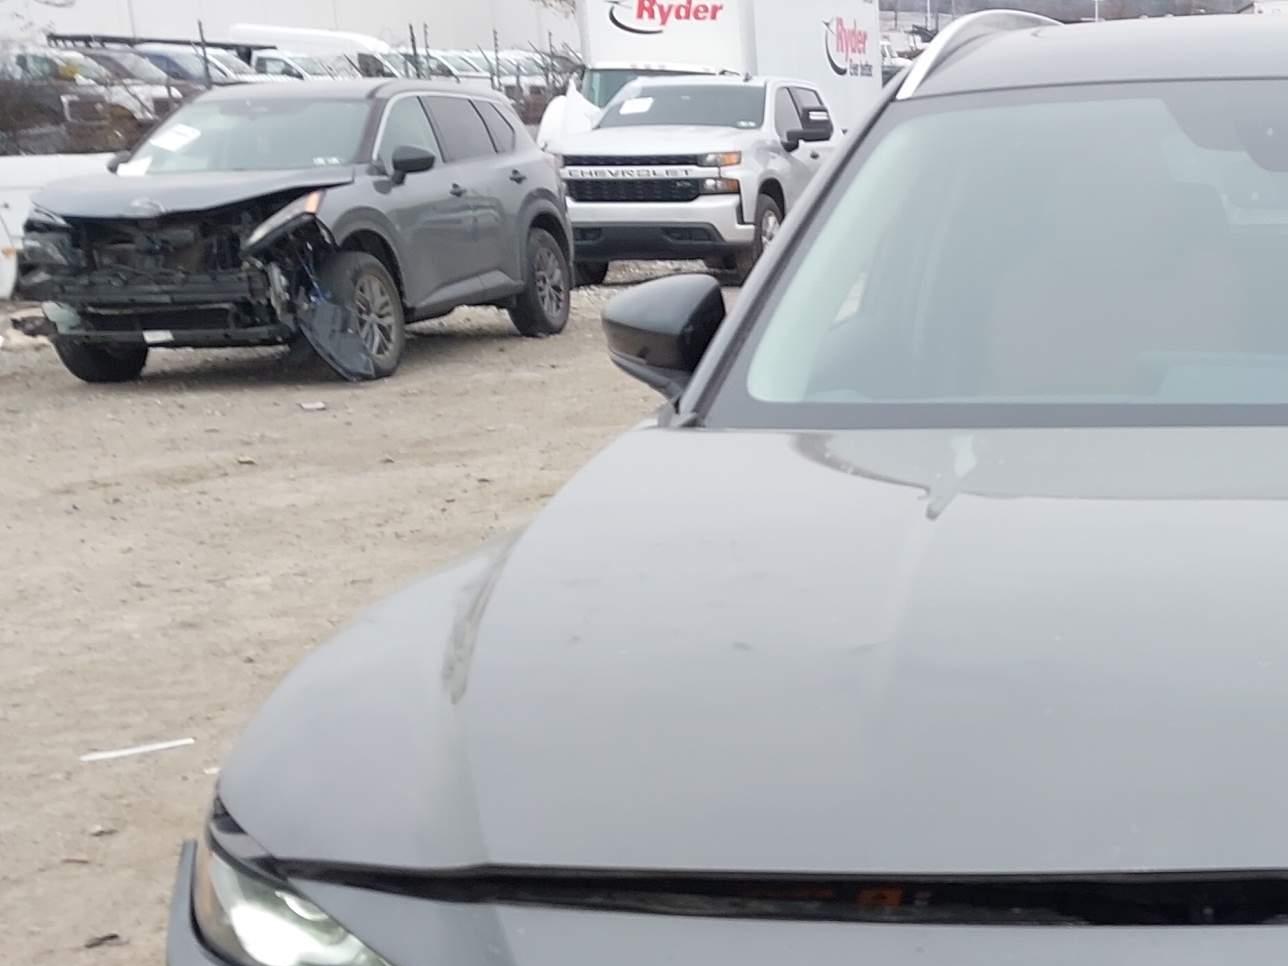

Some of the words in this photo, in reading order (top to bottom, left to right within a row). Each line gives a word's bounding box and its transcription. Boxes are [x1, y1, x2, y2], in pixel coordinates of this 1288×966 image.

[636, 0, 724, 25] Ryder
[836, 16, 868, 62] Ryder
[568, 168, 693, 178] CHEVROLET
